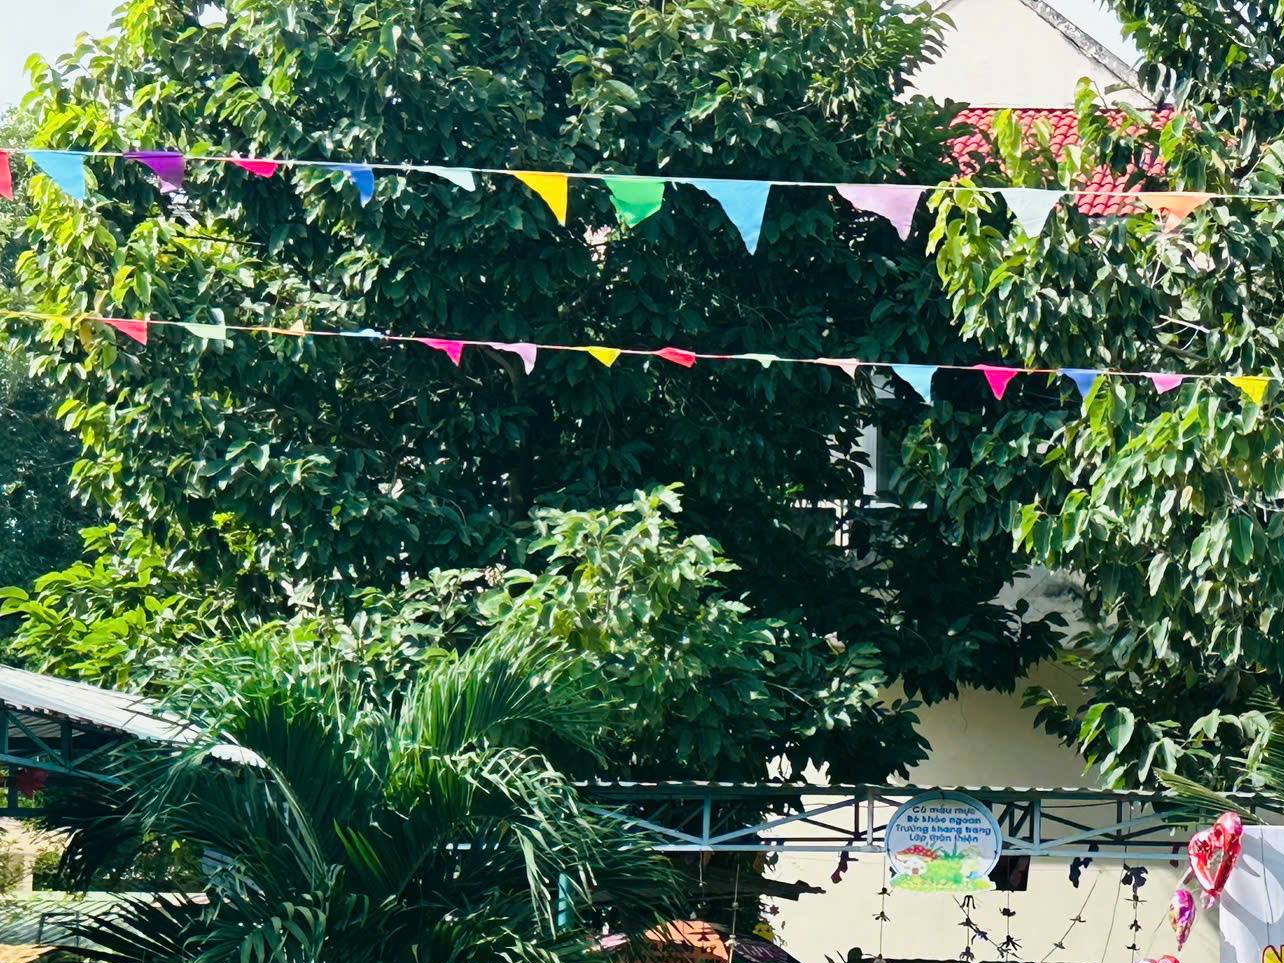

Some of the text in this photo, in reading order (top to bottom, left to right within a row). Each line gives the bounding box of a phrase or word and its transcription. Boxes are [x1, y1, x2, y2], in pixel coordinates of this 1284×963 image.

[949, 816, 981, 826] ngoan
[896, 824, 992, 835] Trường khang trang
